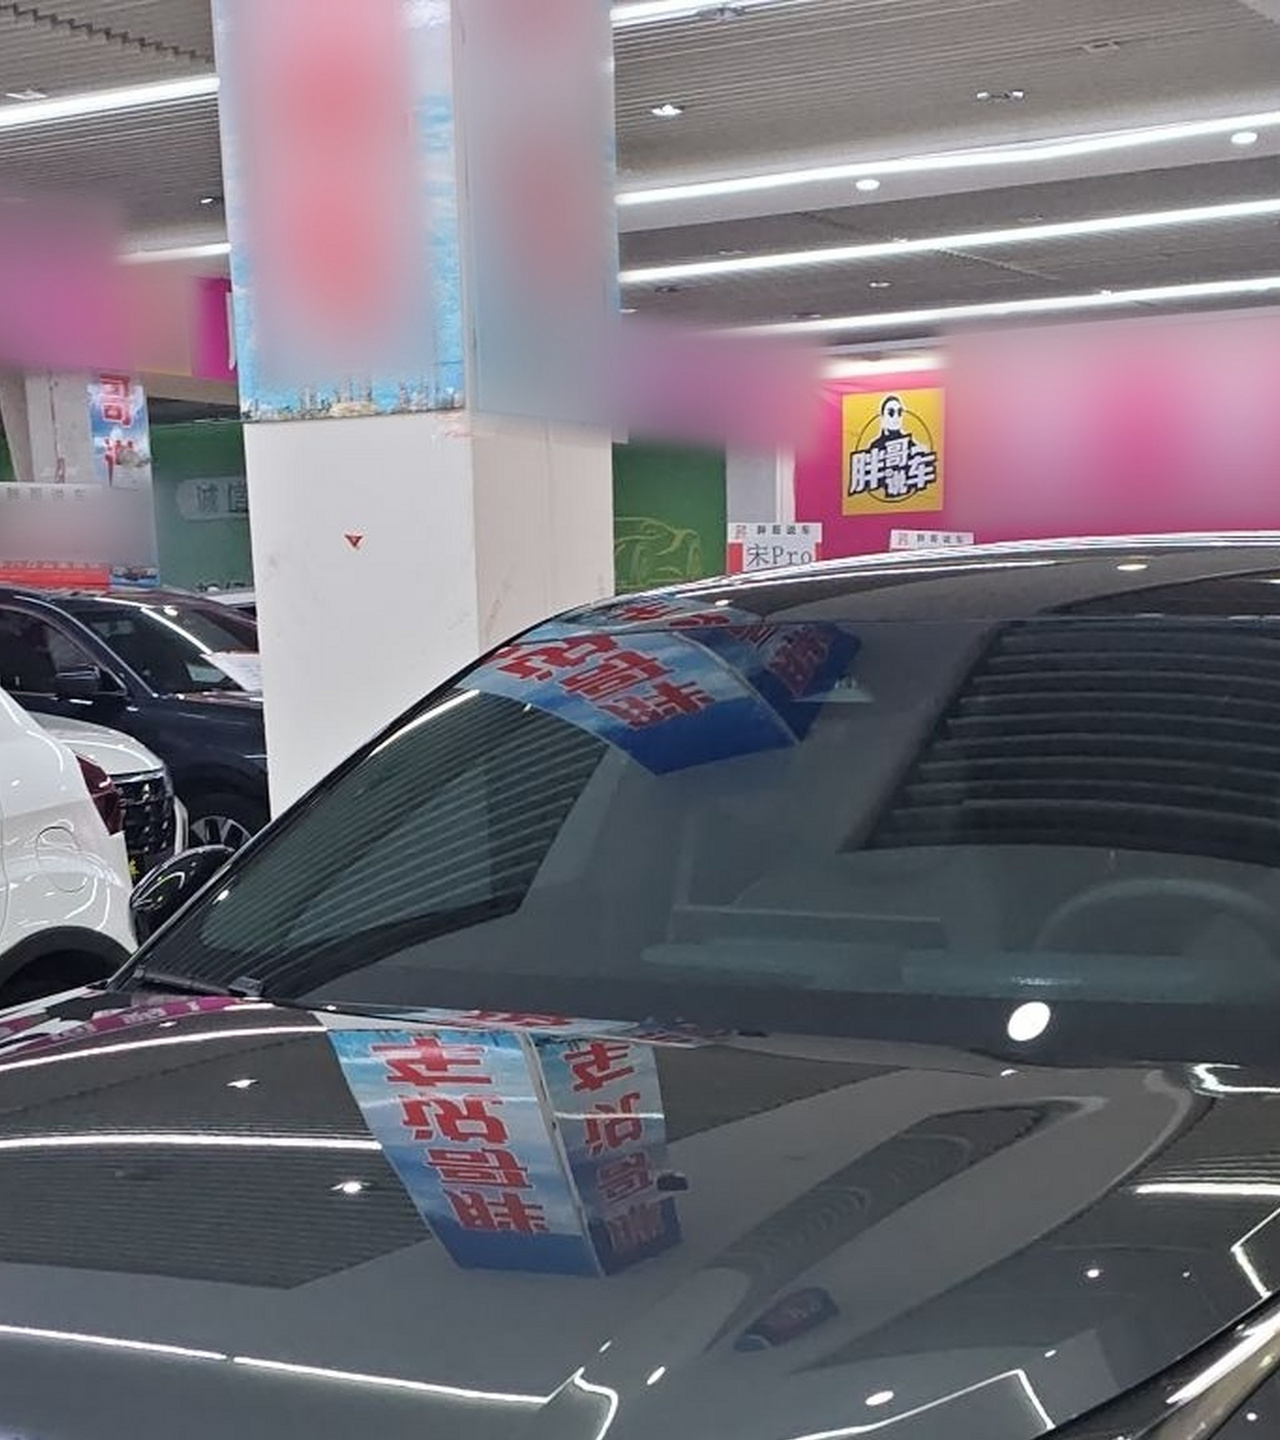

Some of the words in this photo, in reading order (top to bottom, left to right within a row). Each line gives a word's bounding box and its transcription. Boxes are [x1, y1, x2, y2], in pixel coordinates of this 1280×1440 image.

[850, 437, 936, 496] 胖哥说车
[746, 543, 813, 568] 宋Pro
